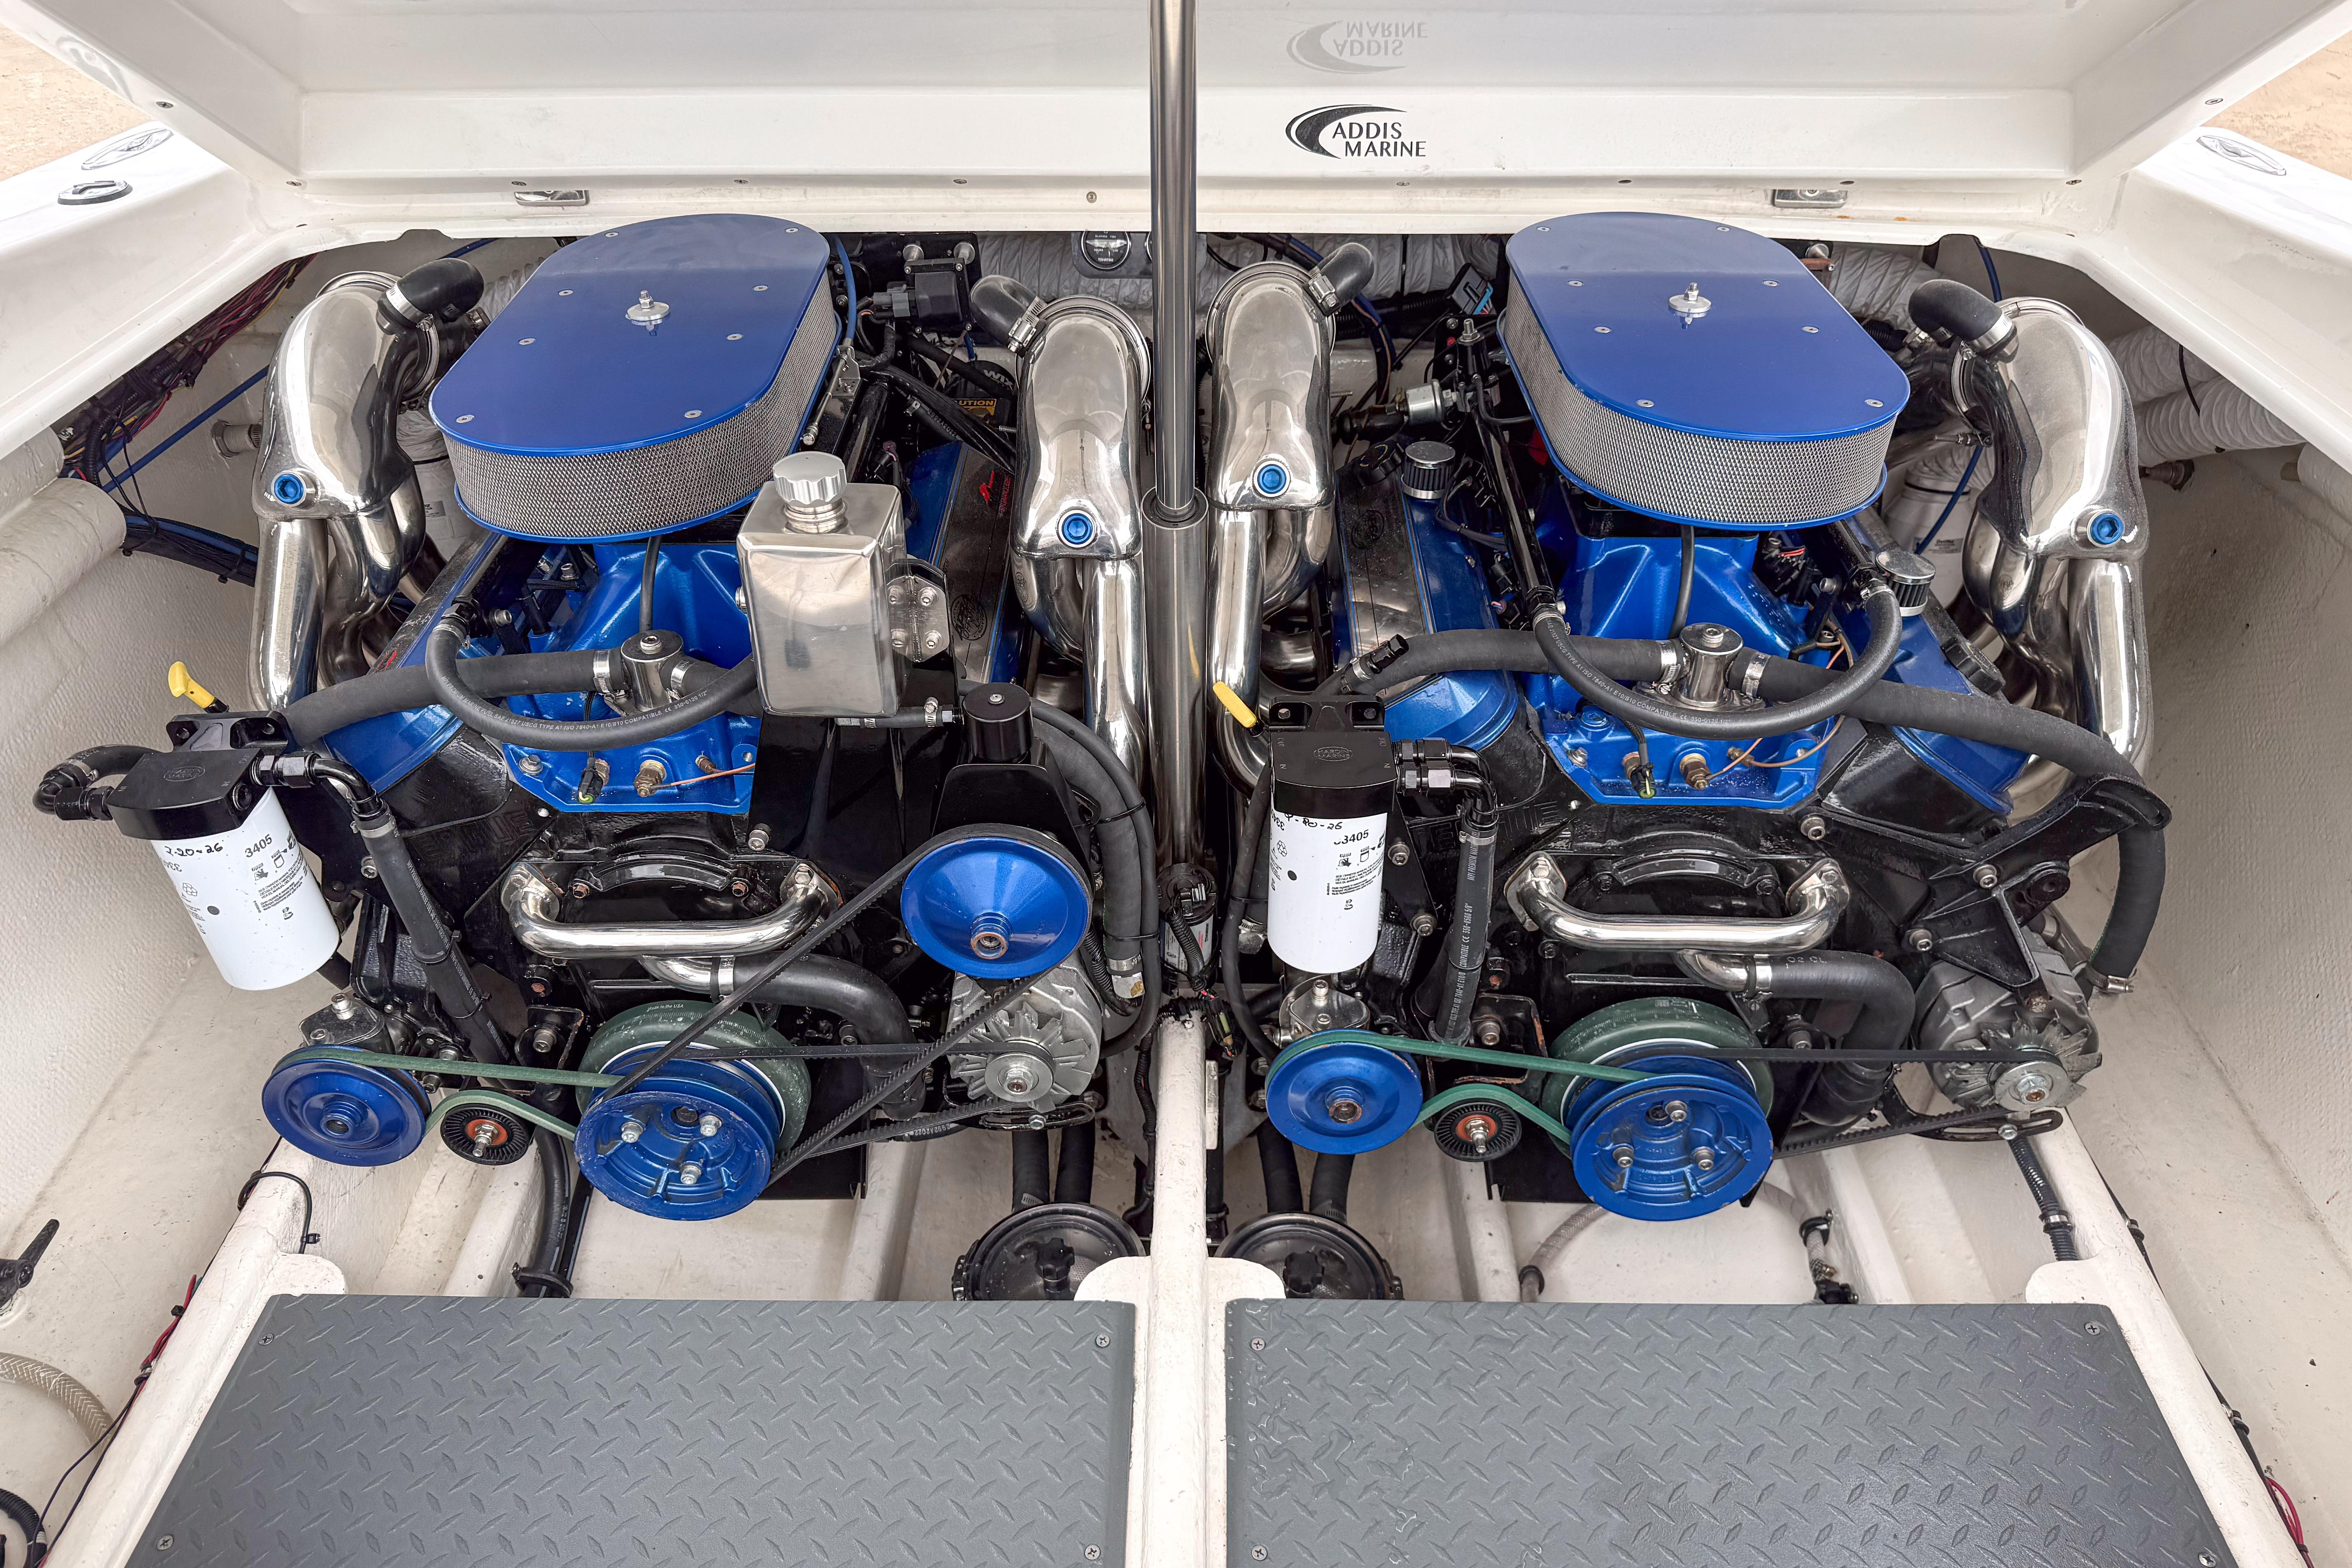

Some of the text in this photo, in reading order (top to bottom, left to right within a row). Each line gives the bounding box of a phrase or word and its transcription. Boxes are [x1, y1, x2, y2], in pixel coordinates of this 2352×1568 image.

[1332, 122, 1402, 139] ADDIS
[1345, 141, 1426, 157] MARINE
[983, 370, 1013, 391] WIX
[1556, 639, 1568, 653] USCG
[1565, 651, 1578, 665] TYPE
[1582, 668, 1593, 678] ISO
[1613, 690, 1636, 705] E10/B10
[1637, 701, 1677, 719] COMPATIBLE
[447, 682, 464, 701] PREMIUM
[463, 697, 481, 711] MARINE
[480, 708, 496, 719] FUEL
[625, 710, 663, 725] COMPATIBLE
[673, 695, 699, 710] 350-0120
[1469, 843, 1479, 856] MARIN
[1459, 944, 1469, 968] COMPATIBLE
[1457, 972, 1466, 983] E10/B
